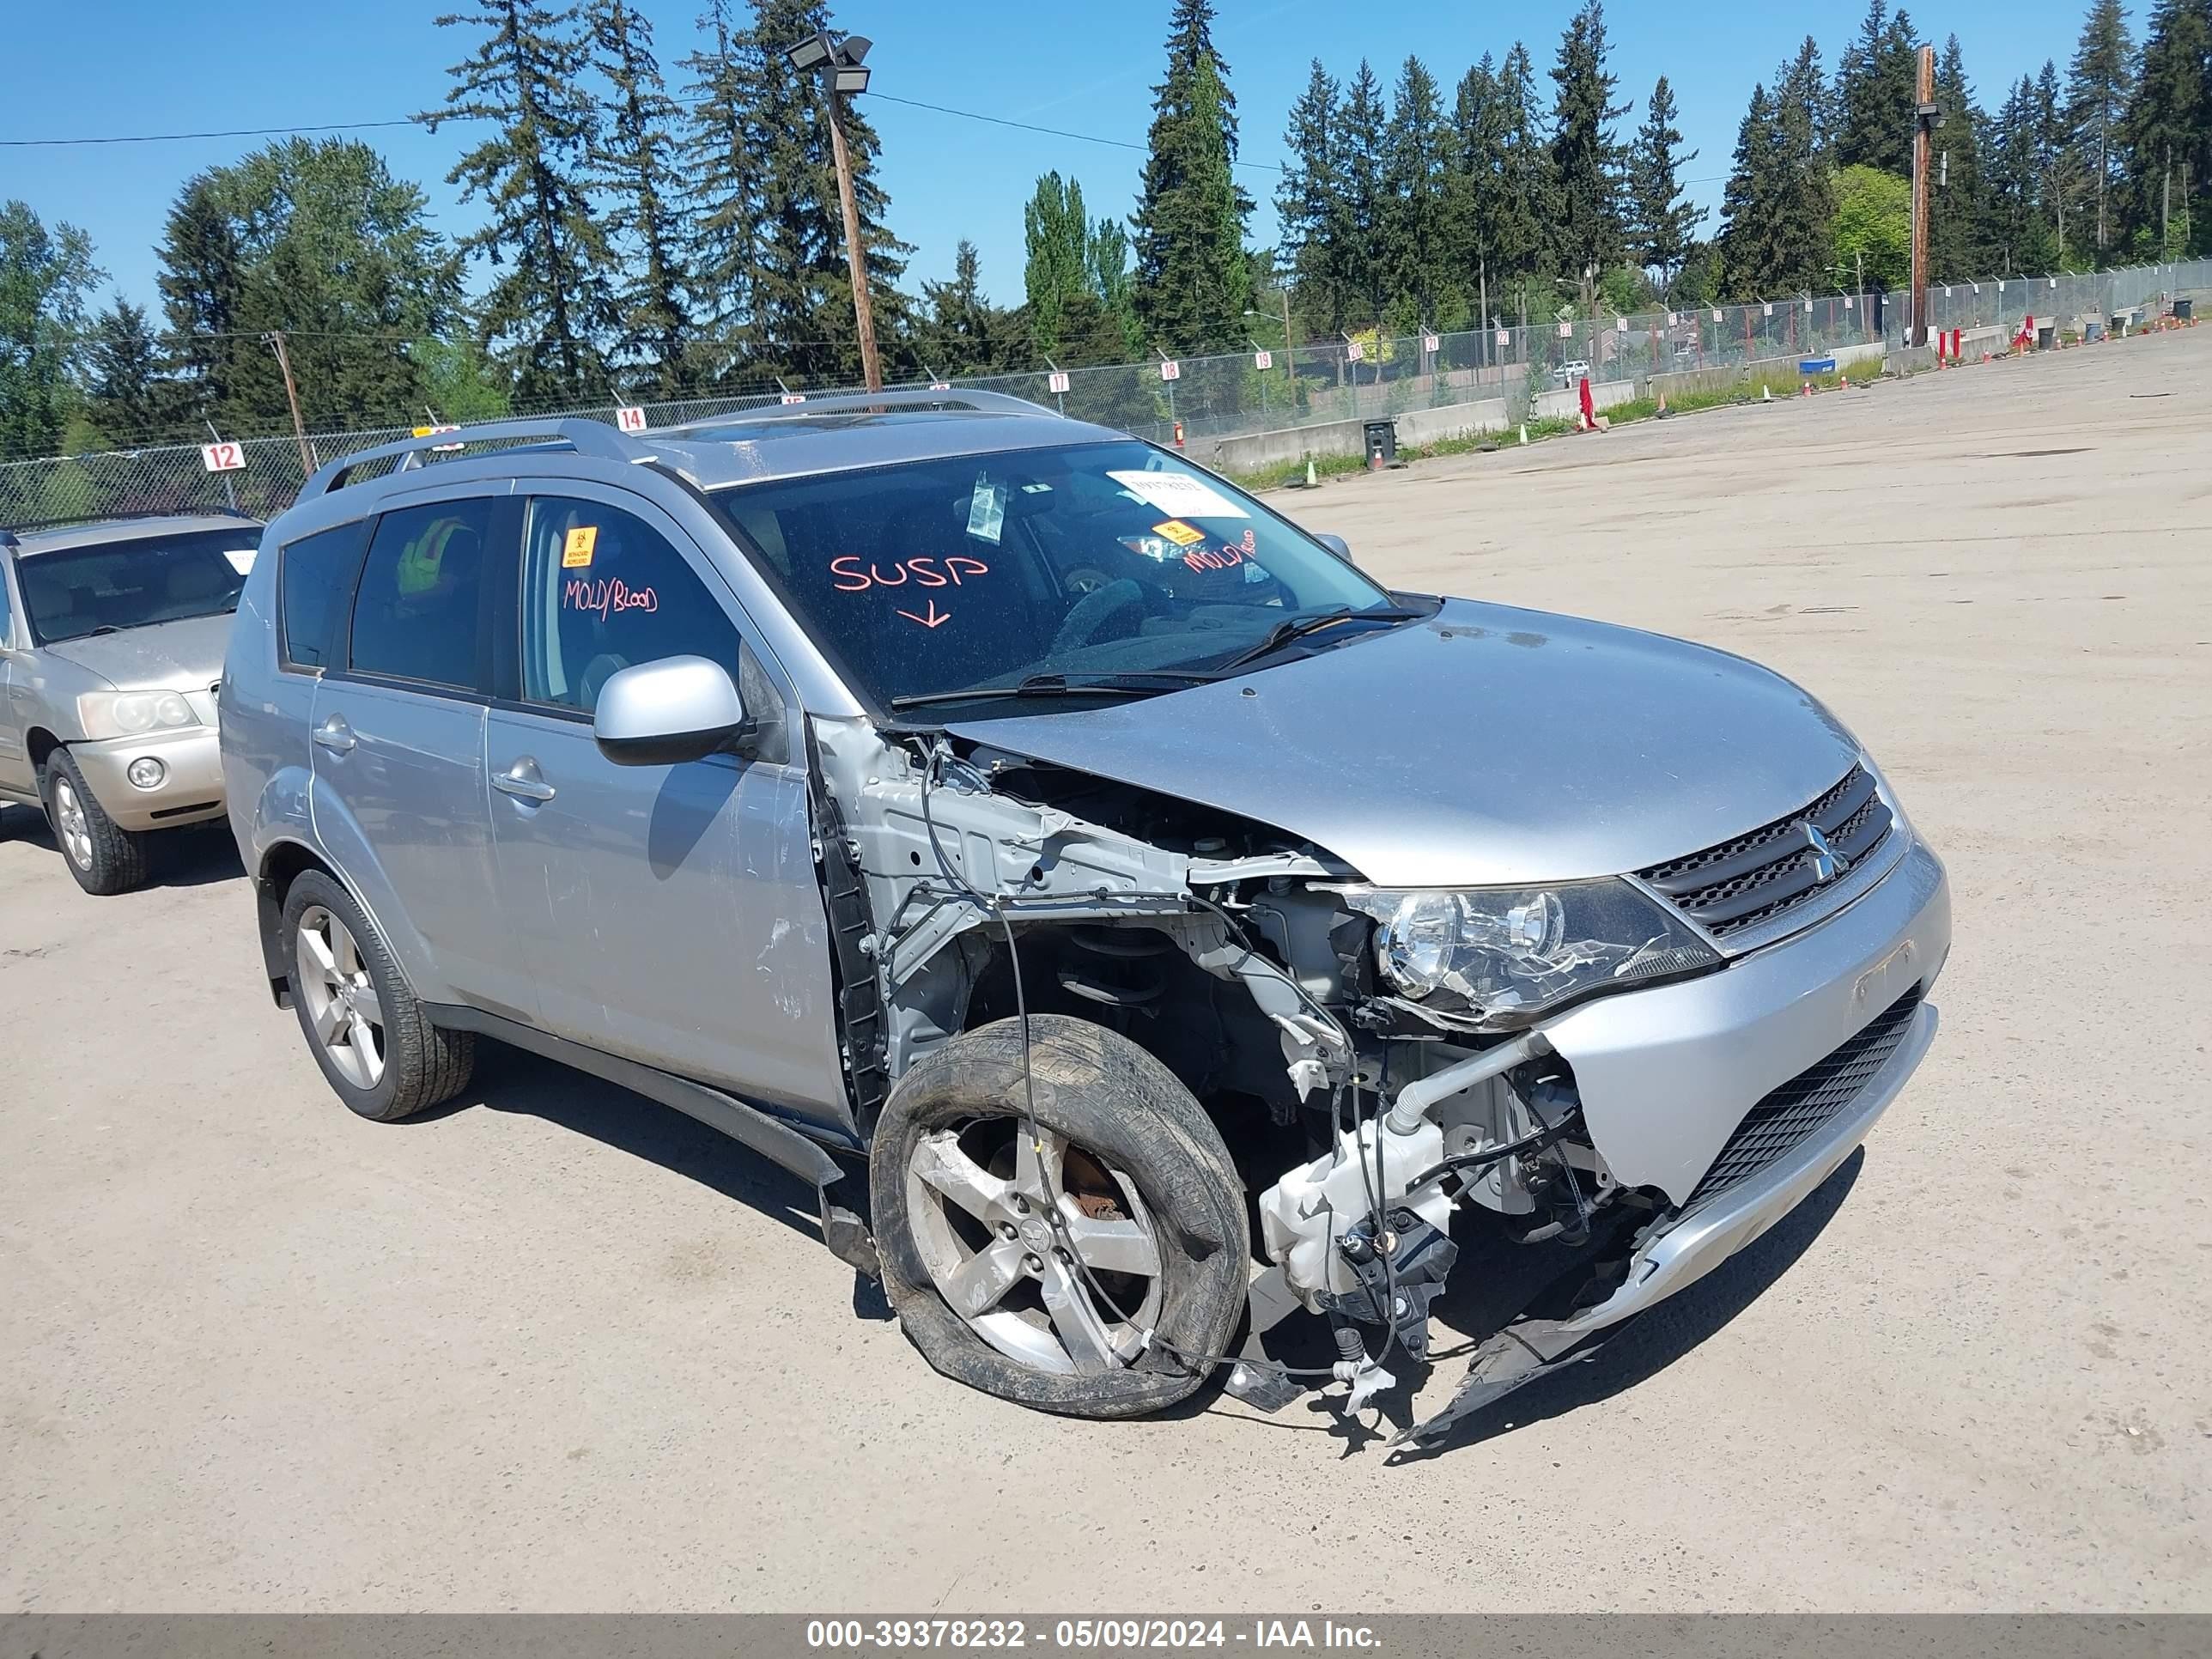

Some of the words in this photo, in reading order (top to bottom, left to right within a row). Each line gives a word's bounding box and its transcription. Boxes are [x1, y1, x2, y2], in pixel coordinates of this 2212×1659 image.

[1765, 306, 1771, 315] 27
[1618, 319, 1626, 331] 24
[1668, 314, 1676, 325] 25
[1560, 325, 1571, 336] 23
[1427, 338, 1437, 349] 21
[1498, 332, 1508, 343] 22
[1259, 354, 1269, 368] 19
[1350, 348, 1361, 361] 20
[1164, 363, 1176, 379] 18
[1054, 374, 1065, 392] 17
[622, 410, 641, 428] 14
[210, 445, 238, 468] 12
[830, 556, 989, 591] SUSP
